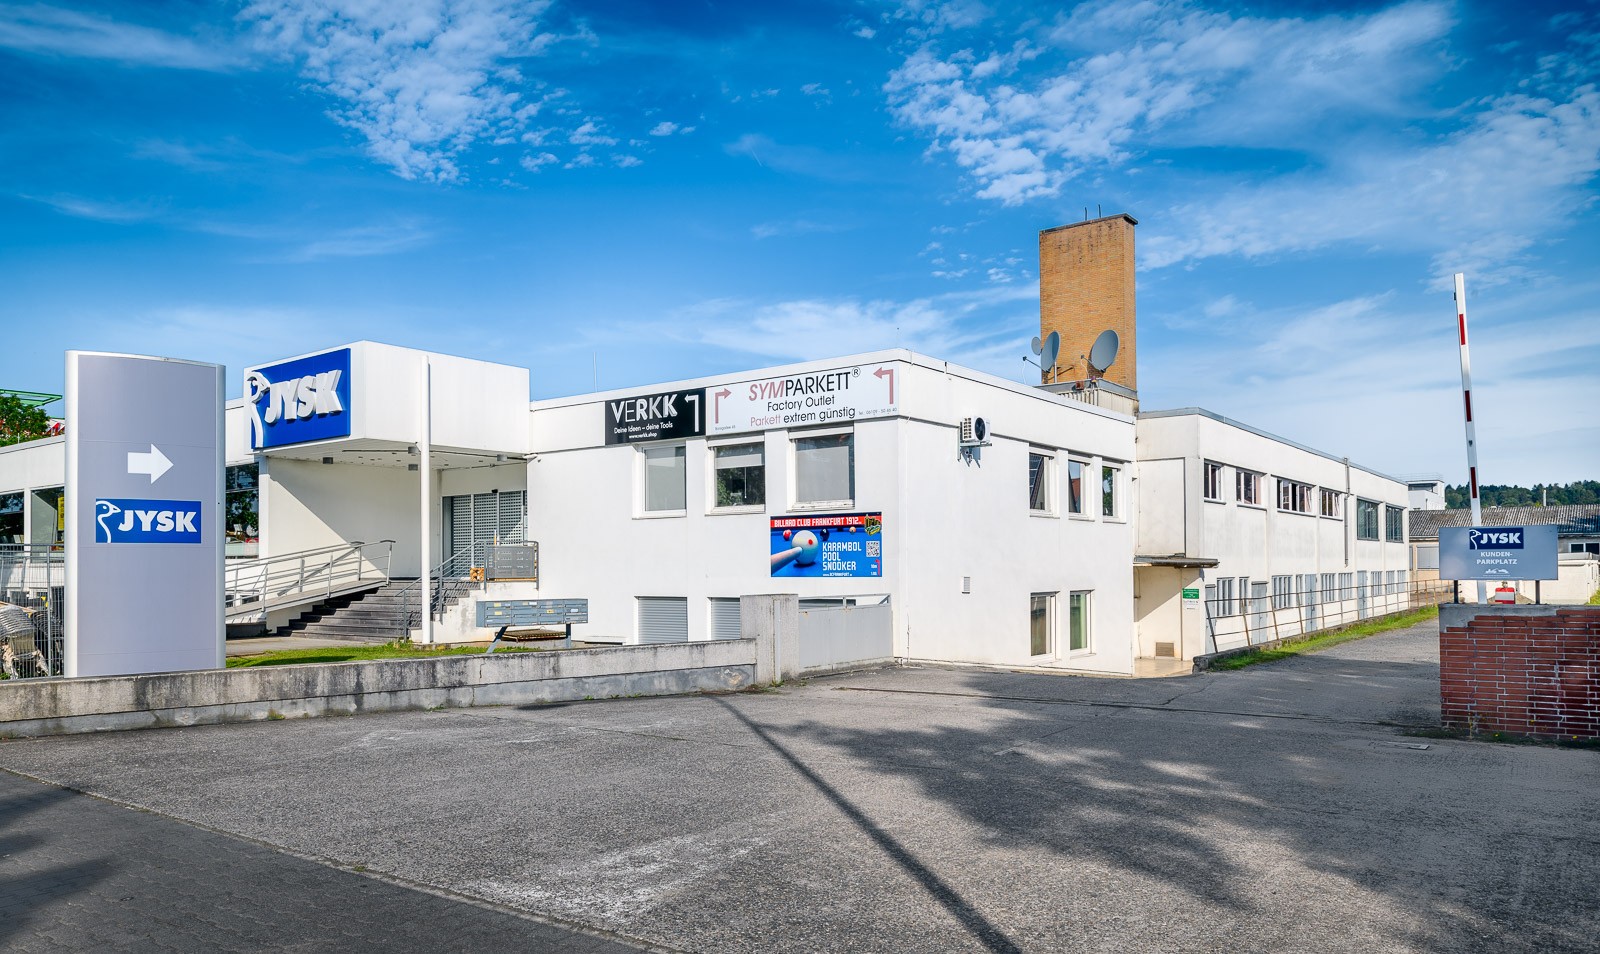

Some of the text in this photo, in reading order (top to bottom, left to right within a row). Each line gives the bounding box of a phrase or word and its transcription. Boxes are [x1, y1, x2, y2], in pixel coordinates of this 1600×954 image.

[264, 369, 343, 424] JYSK
[610, 394, 678, 424] VERKK
[767, 394, 835, 412] Factory Outlet
[750, 407, 856, 427] Parkett extrem günstig
[628, 425, 641, 433] Ideen
[646, 423, 660, 431] deine
[660, 421, 673, 429] Tools
[118, 510, 198, 533] JYSK
[774, 519, 796, 528] BILLARD
[797, 518, 811, 527] CLUB
[811, 517, 845, 526] FRANKFURT
[1480, 532, 1522, 544] JYSK
[822, 541, 862, 552] KARAMBOL
[822, 552, 841, 561] POOL
[822, 561, 857, 571] SNOOKER
